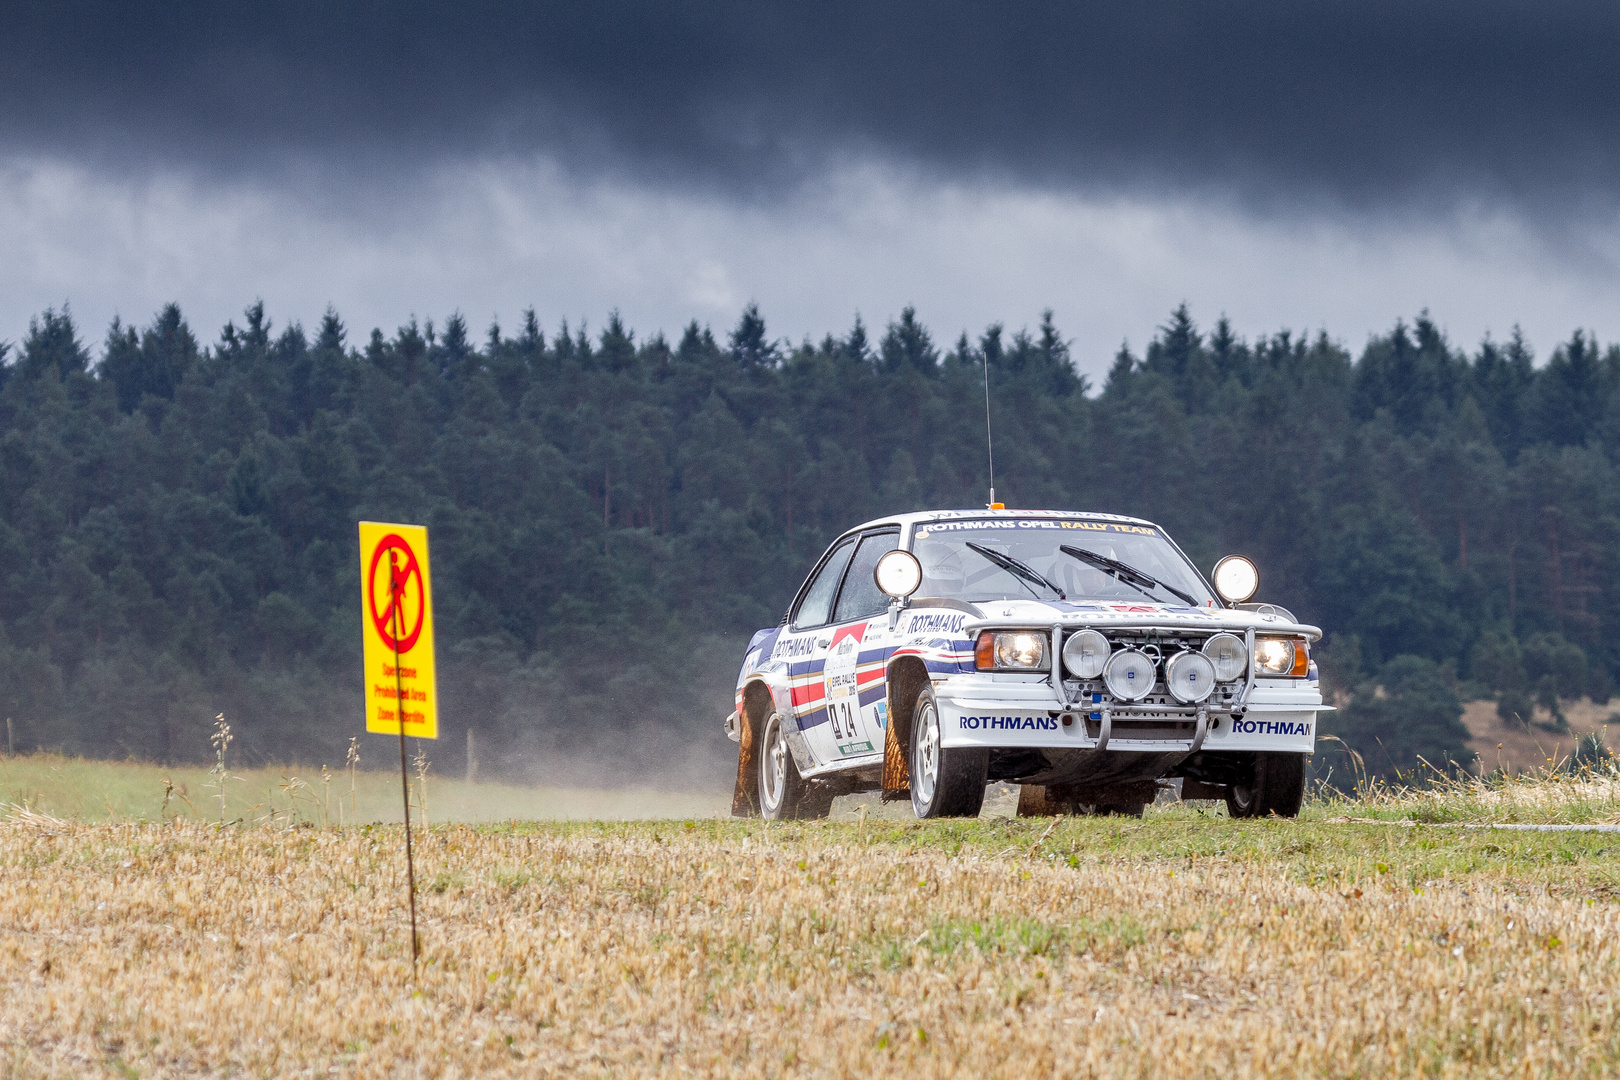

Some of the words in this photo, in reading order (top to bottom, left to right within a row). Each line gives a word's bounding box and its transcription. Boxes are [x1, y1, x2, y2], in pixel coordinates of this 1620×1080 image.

[923, 520, 1015, 532] ROTHMANS
[1018, 520, 1060, 530] OPEL
[1060, 521, 1108, 531] RALLY
[1110, 524, 1156, 537] TEAM
[907, 614, 966, 634] ROTHMANS
[775, 636, 817, 657] ROTHMANS
[377, 706, 395, 721] Zone
[841, 702, 857, 738] 24
[959, 716, 1058, 730] ROTHMANS
